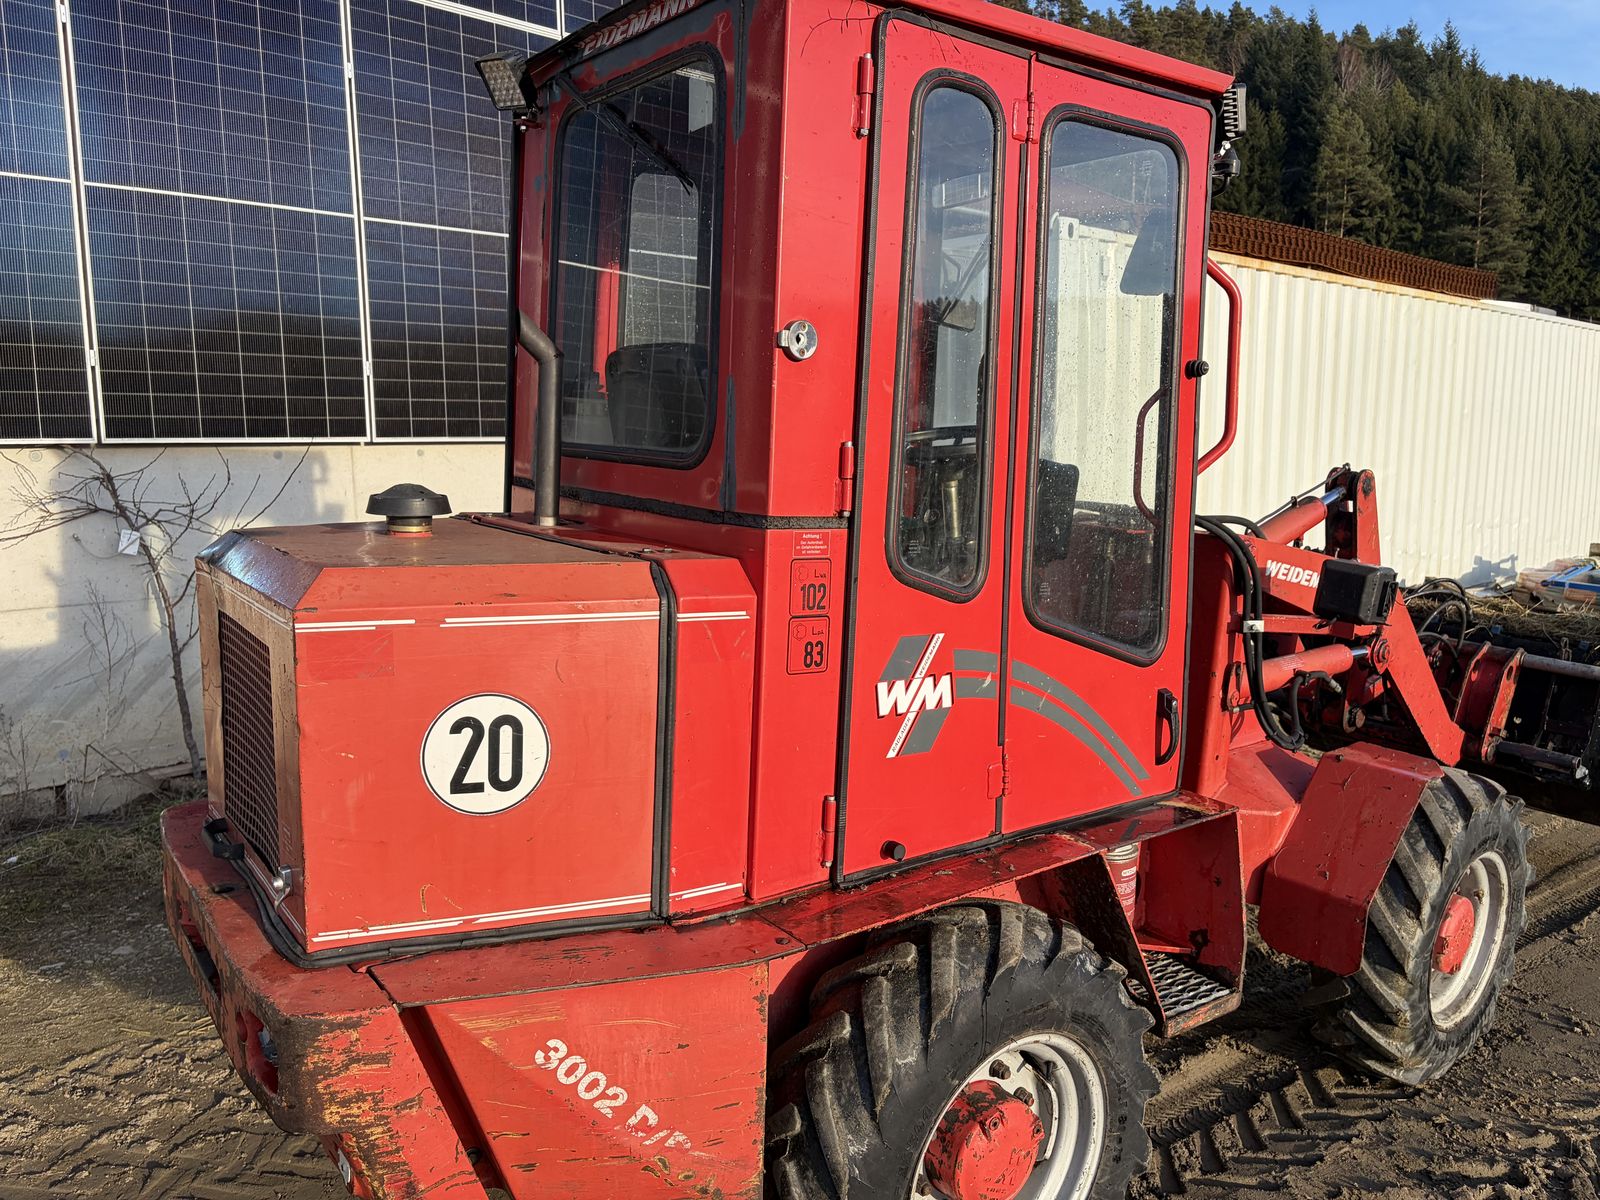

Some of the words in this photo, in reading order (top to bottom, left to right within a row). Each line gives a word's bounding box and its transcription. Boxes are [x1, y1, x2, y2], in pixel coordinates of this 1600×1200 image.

[800, 583, 827, 610] 102
[804, 641, 824, 668] 83
[876, 673, 953, 718] WM
[449, 714, 524, 795] 20
[534, 1038, 629, 1119] 3002
